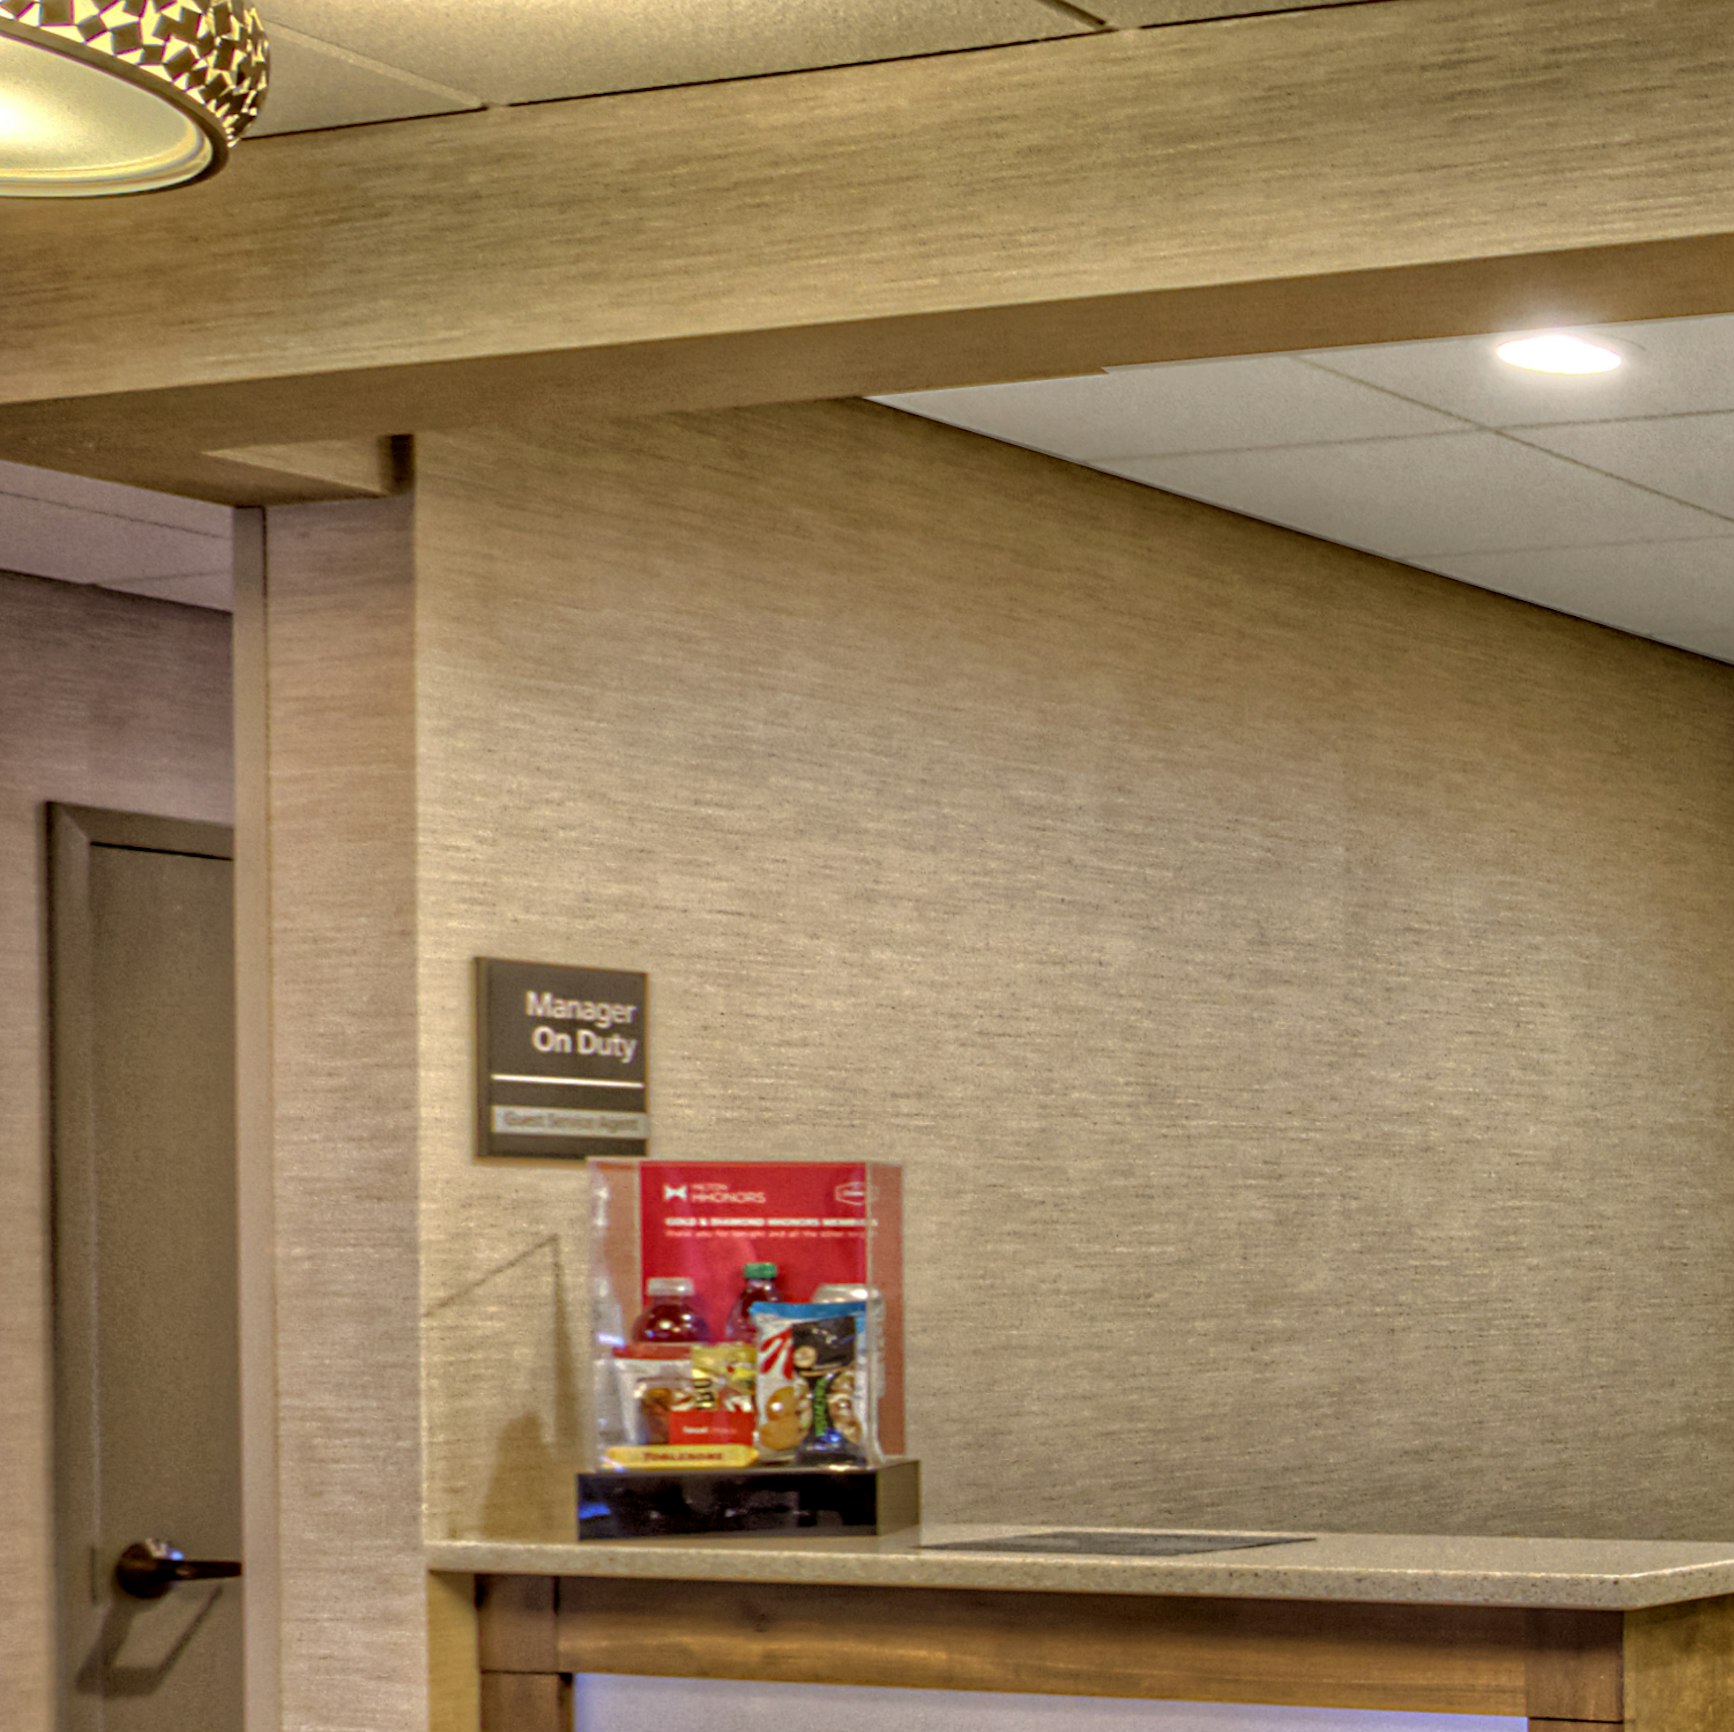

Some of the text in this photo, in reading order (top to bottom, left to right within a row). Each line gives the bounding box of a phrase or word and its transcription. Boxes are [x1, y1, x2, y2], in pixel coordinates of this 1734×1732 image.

[526, 990, 637, 1029] Manager
[532, 1026, 638, 1063] On Duty
[692, 1191, 767, 1203] HHONORS
